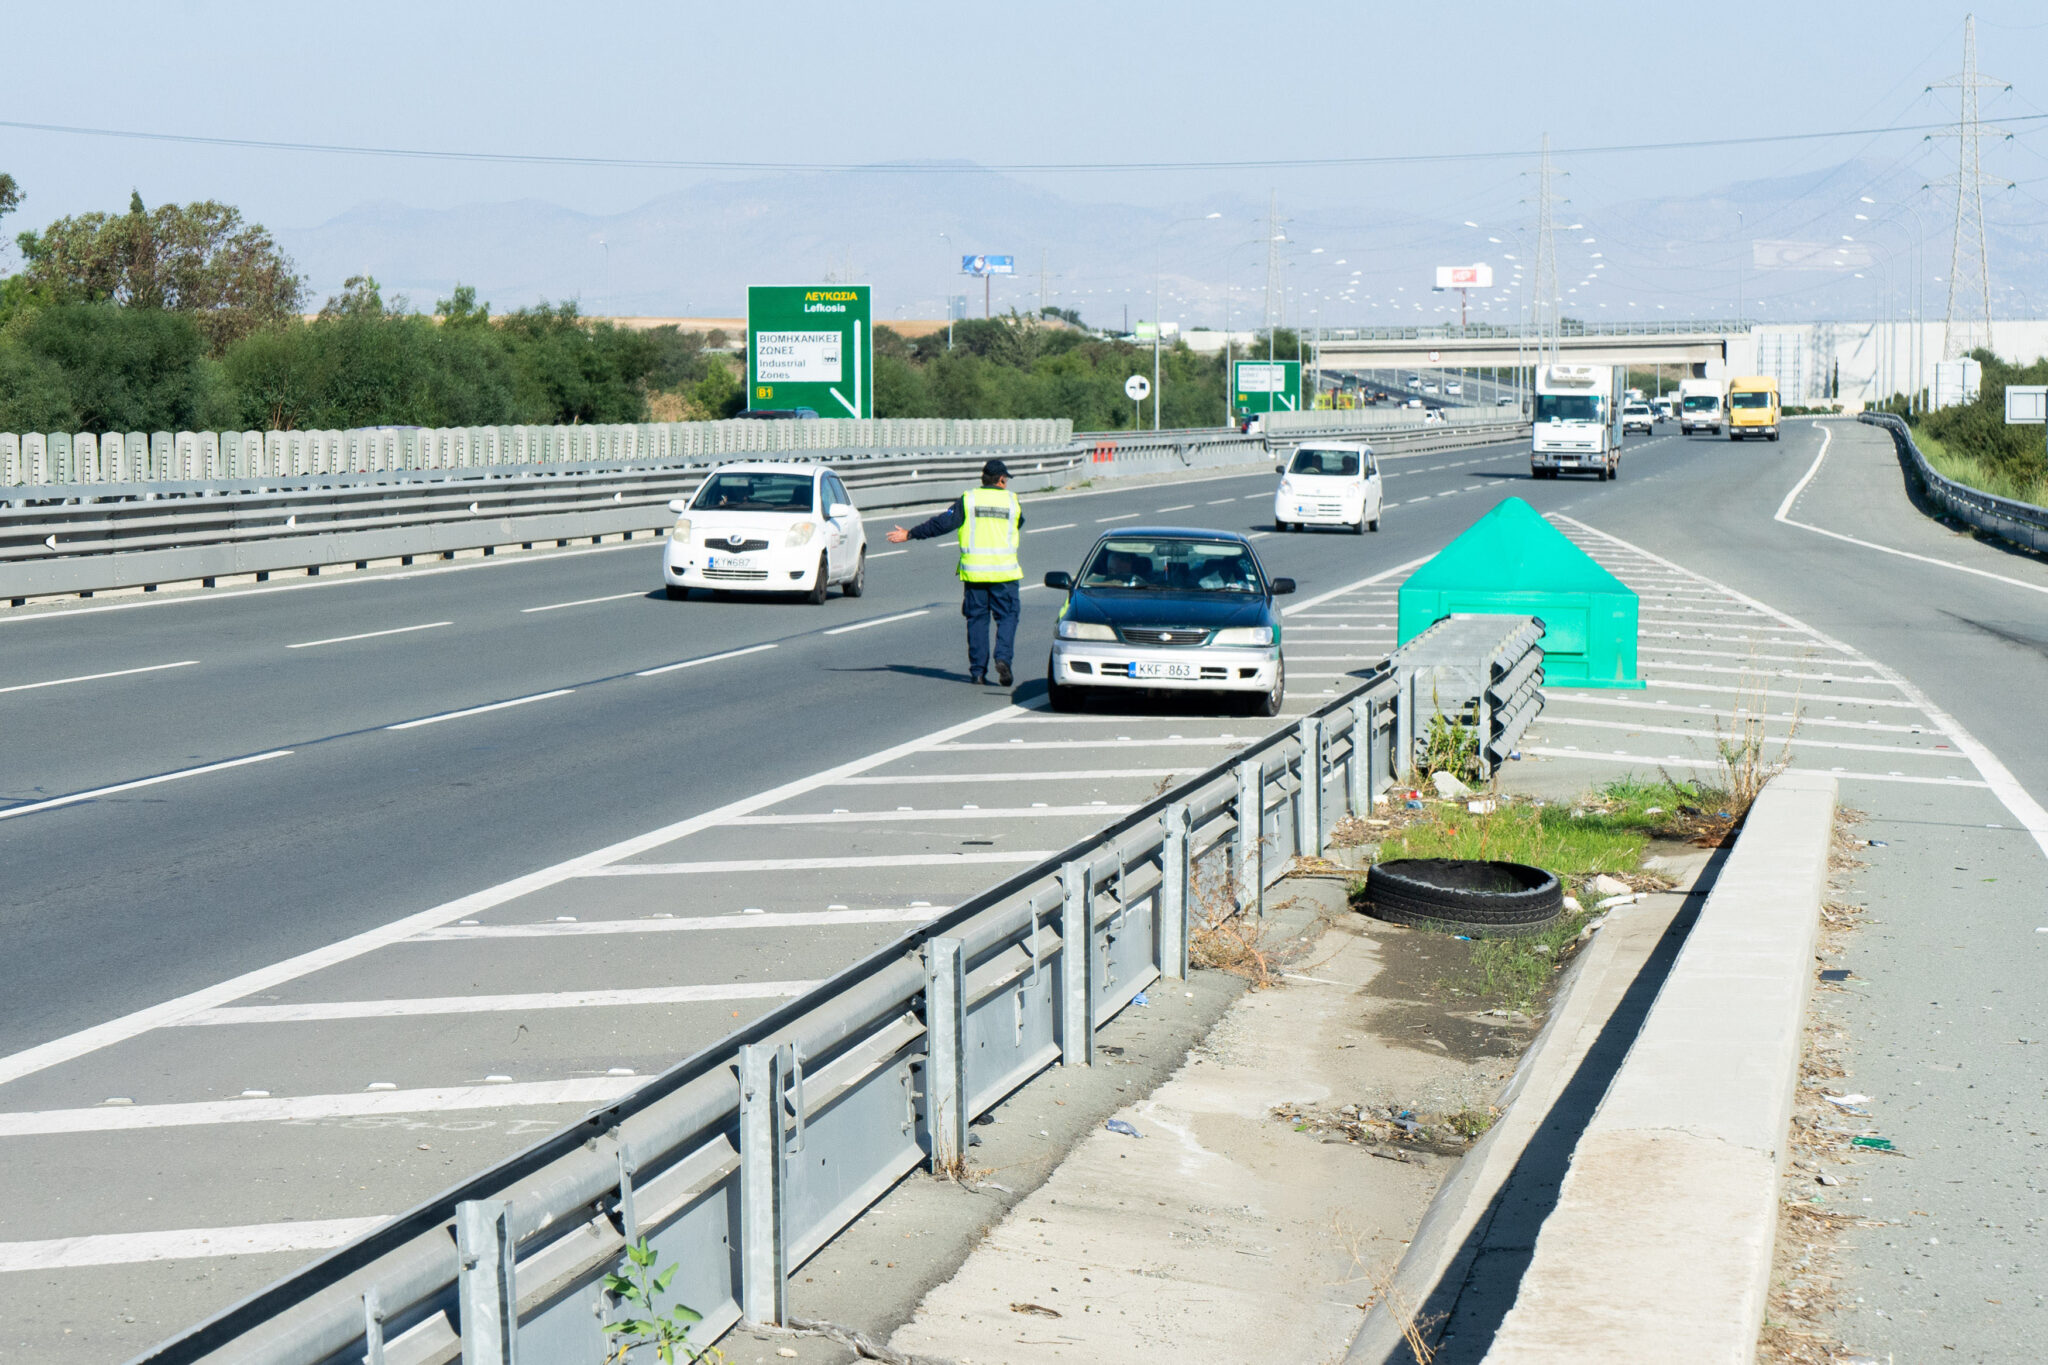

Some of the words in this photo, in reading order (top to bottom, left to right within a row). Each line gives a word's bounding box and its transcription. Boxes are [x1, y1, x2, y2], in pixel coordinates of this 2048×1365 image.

[805, 291, 858, 301] ΛΕΥΚΩΣΙΑ
[804, 303, 846, 312] Lefkosia
[759, 334, 839, 343] ΒΙΟΜΗΧΑΝΙΚΕΣ
[759, 346, 794, 355] ΖΩΝΕΣ
[759, 359, 806, 368] Industrial
[760, 370, 790, 379] Zones
[759, 388, 771, 397] B1
[1139, 664, 1162, 675] KKF
[1169, 665, 1190, 676] 863
